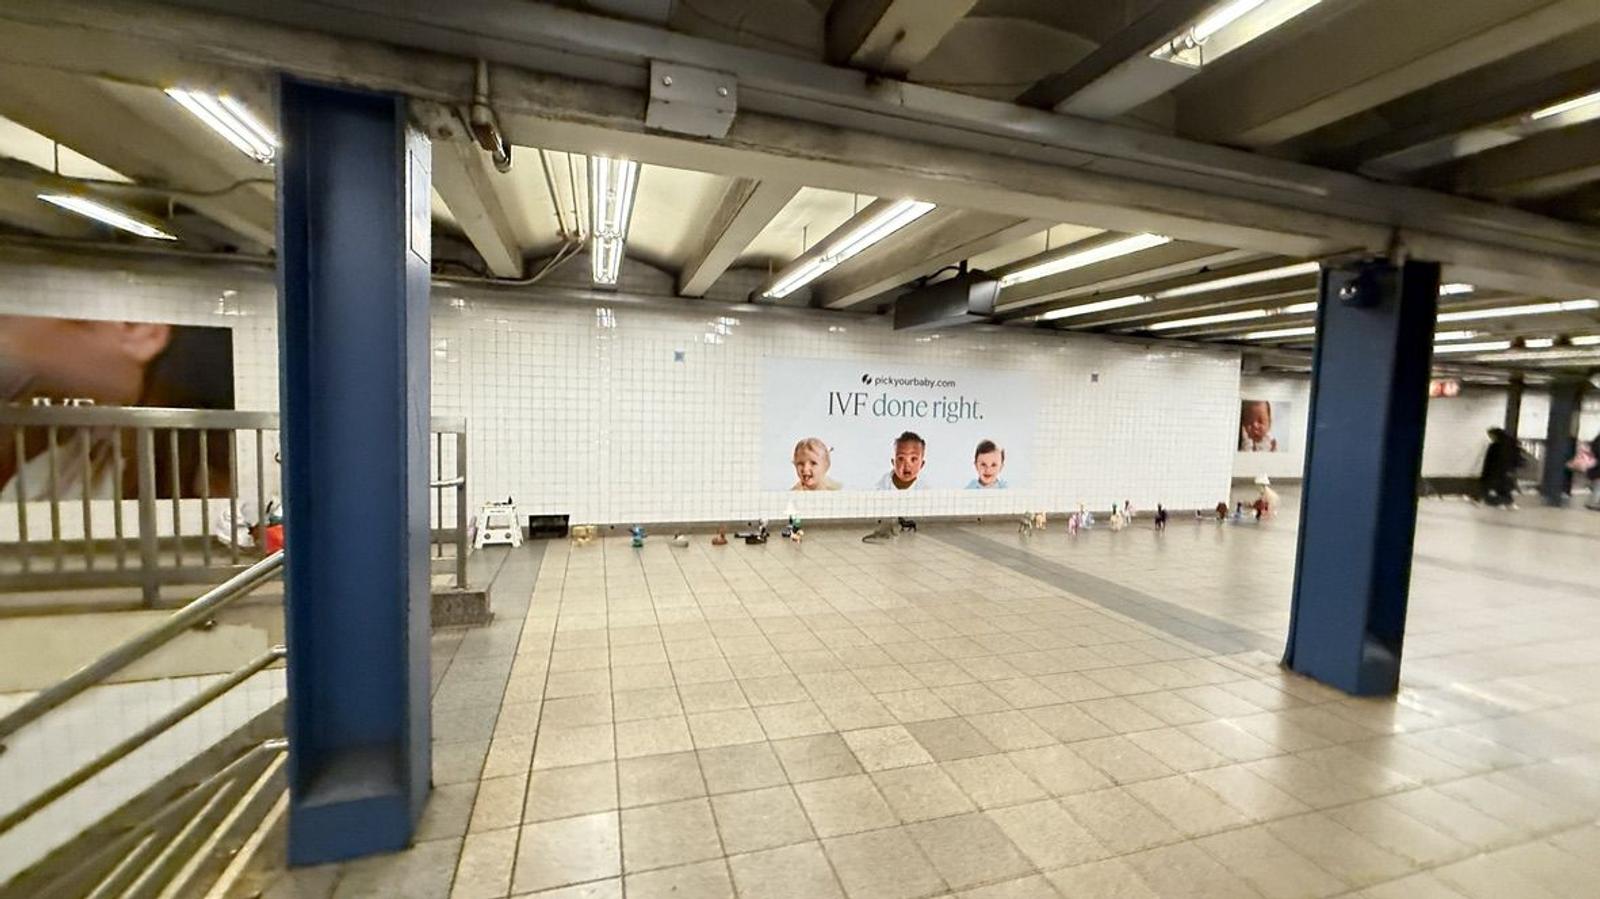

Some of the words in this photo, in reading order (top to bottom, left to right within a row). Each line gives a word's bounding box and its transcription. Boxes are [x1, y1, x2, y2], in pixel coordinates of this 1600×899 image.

[874, 376, 956, 388] pickyourbaby.com
[828, 391, 868, 416] IVF
[872, 393, 928, 417] done
[932, 396, 984, 423] right.
